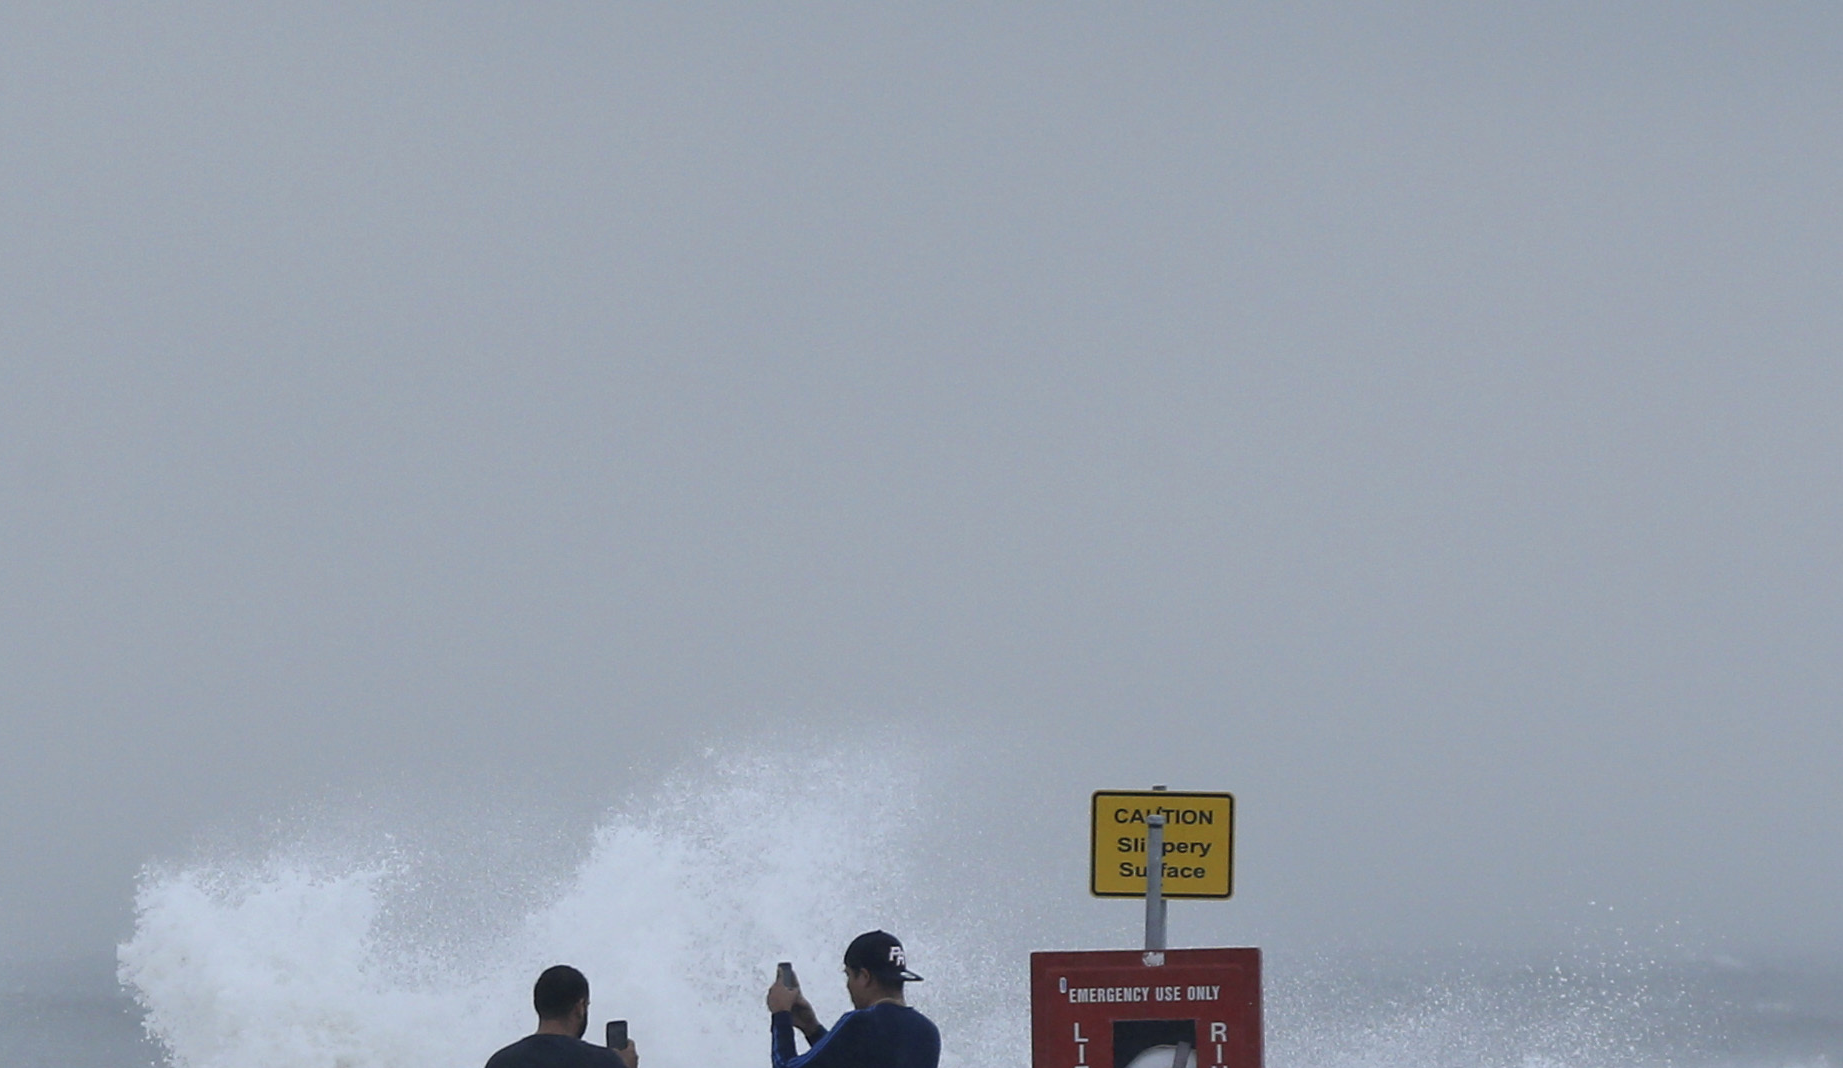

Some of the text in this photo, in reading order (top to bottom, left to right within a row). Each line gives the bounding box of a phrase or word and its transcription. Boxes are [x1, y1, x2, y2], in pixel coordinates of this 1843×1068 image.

[1117, 837, 1212, 858] Slipery
[1119, 862, 1206, 879] Suface
[1068, 985, 1220, 1003] EMERGENCY USE ONLY
